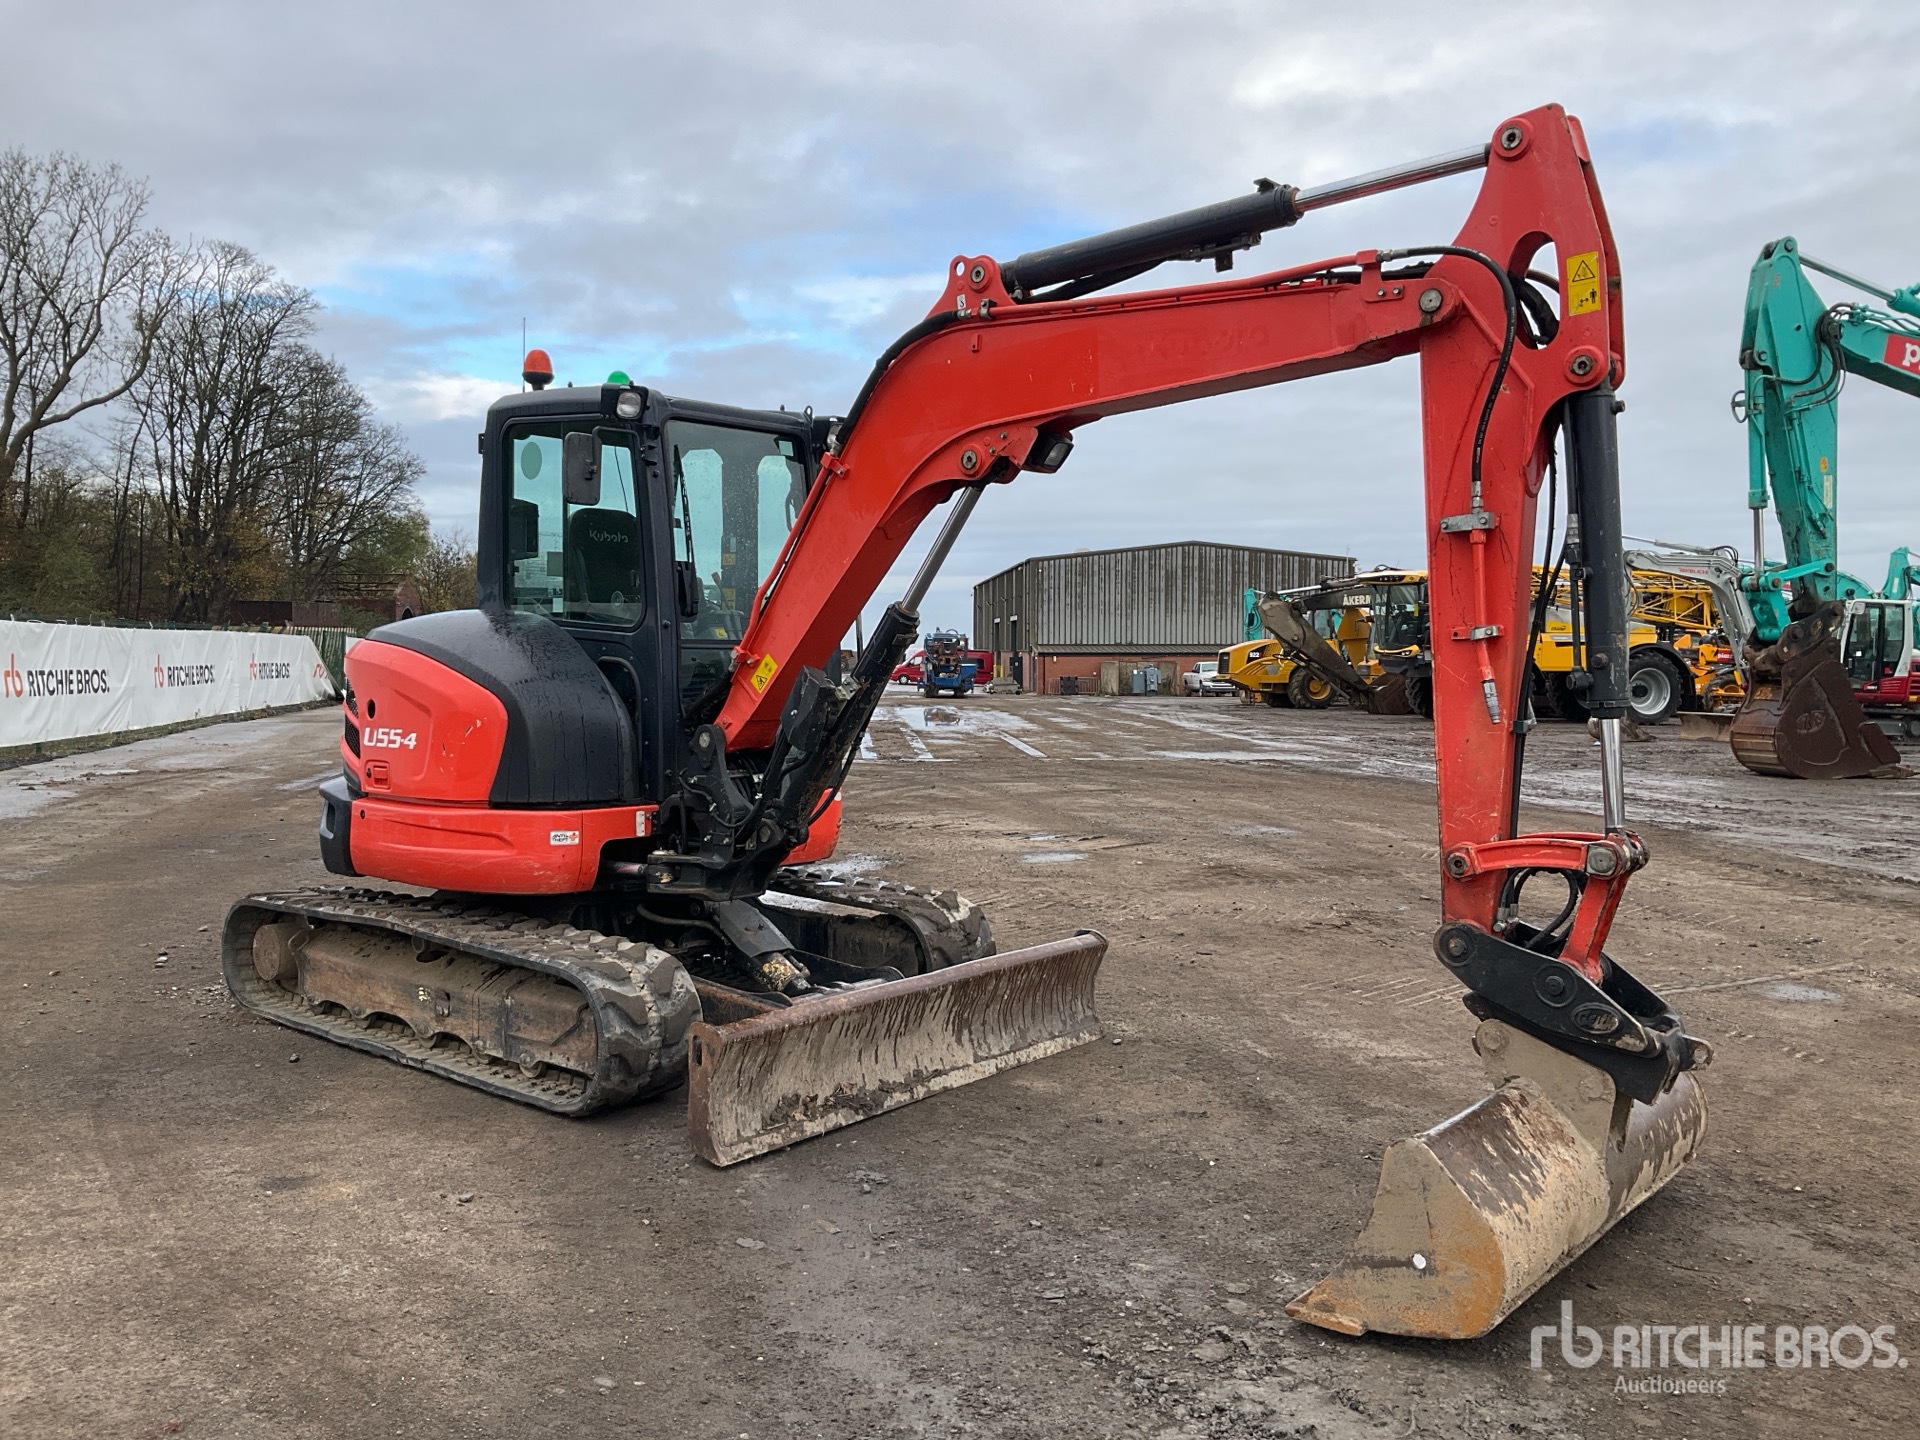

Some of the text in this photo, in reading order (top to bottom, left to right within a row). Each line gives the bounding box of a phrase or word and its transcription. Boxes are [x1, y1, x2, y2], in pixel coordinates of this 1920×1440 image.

[1902, 343, 1920, 370] p
[589, 529, 629, 543] Kubota
[4, 654, 111, 698] rb RITCHIE BROS.
[167, 665, 195, 688] RITCHIE
[195, 664, 216, 685] BROS.
[258, 662, 274, 680] RITCHIE
[363, 727, 417, 749] U55-4
